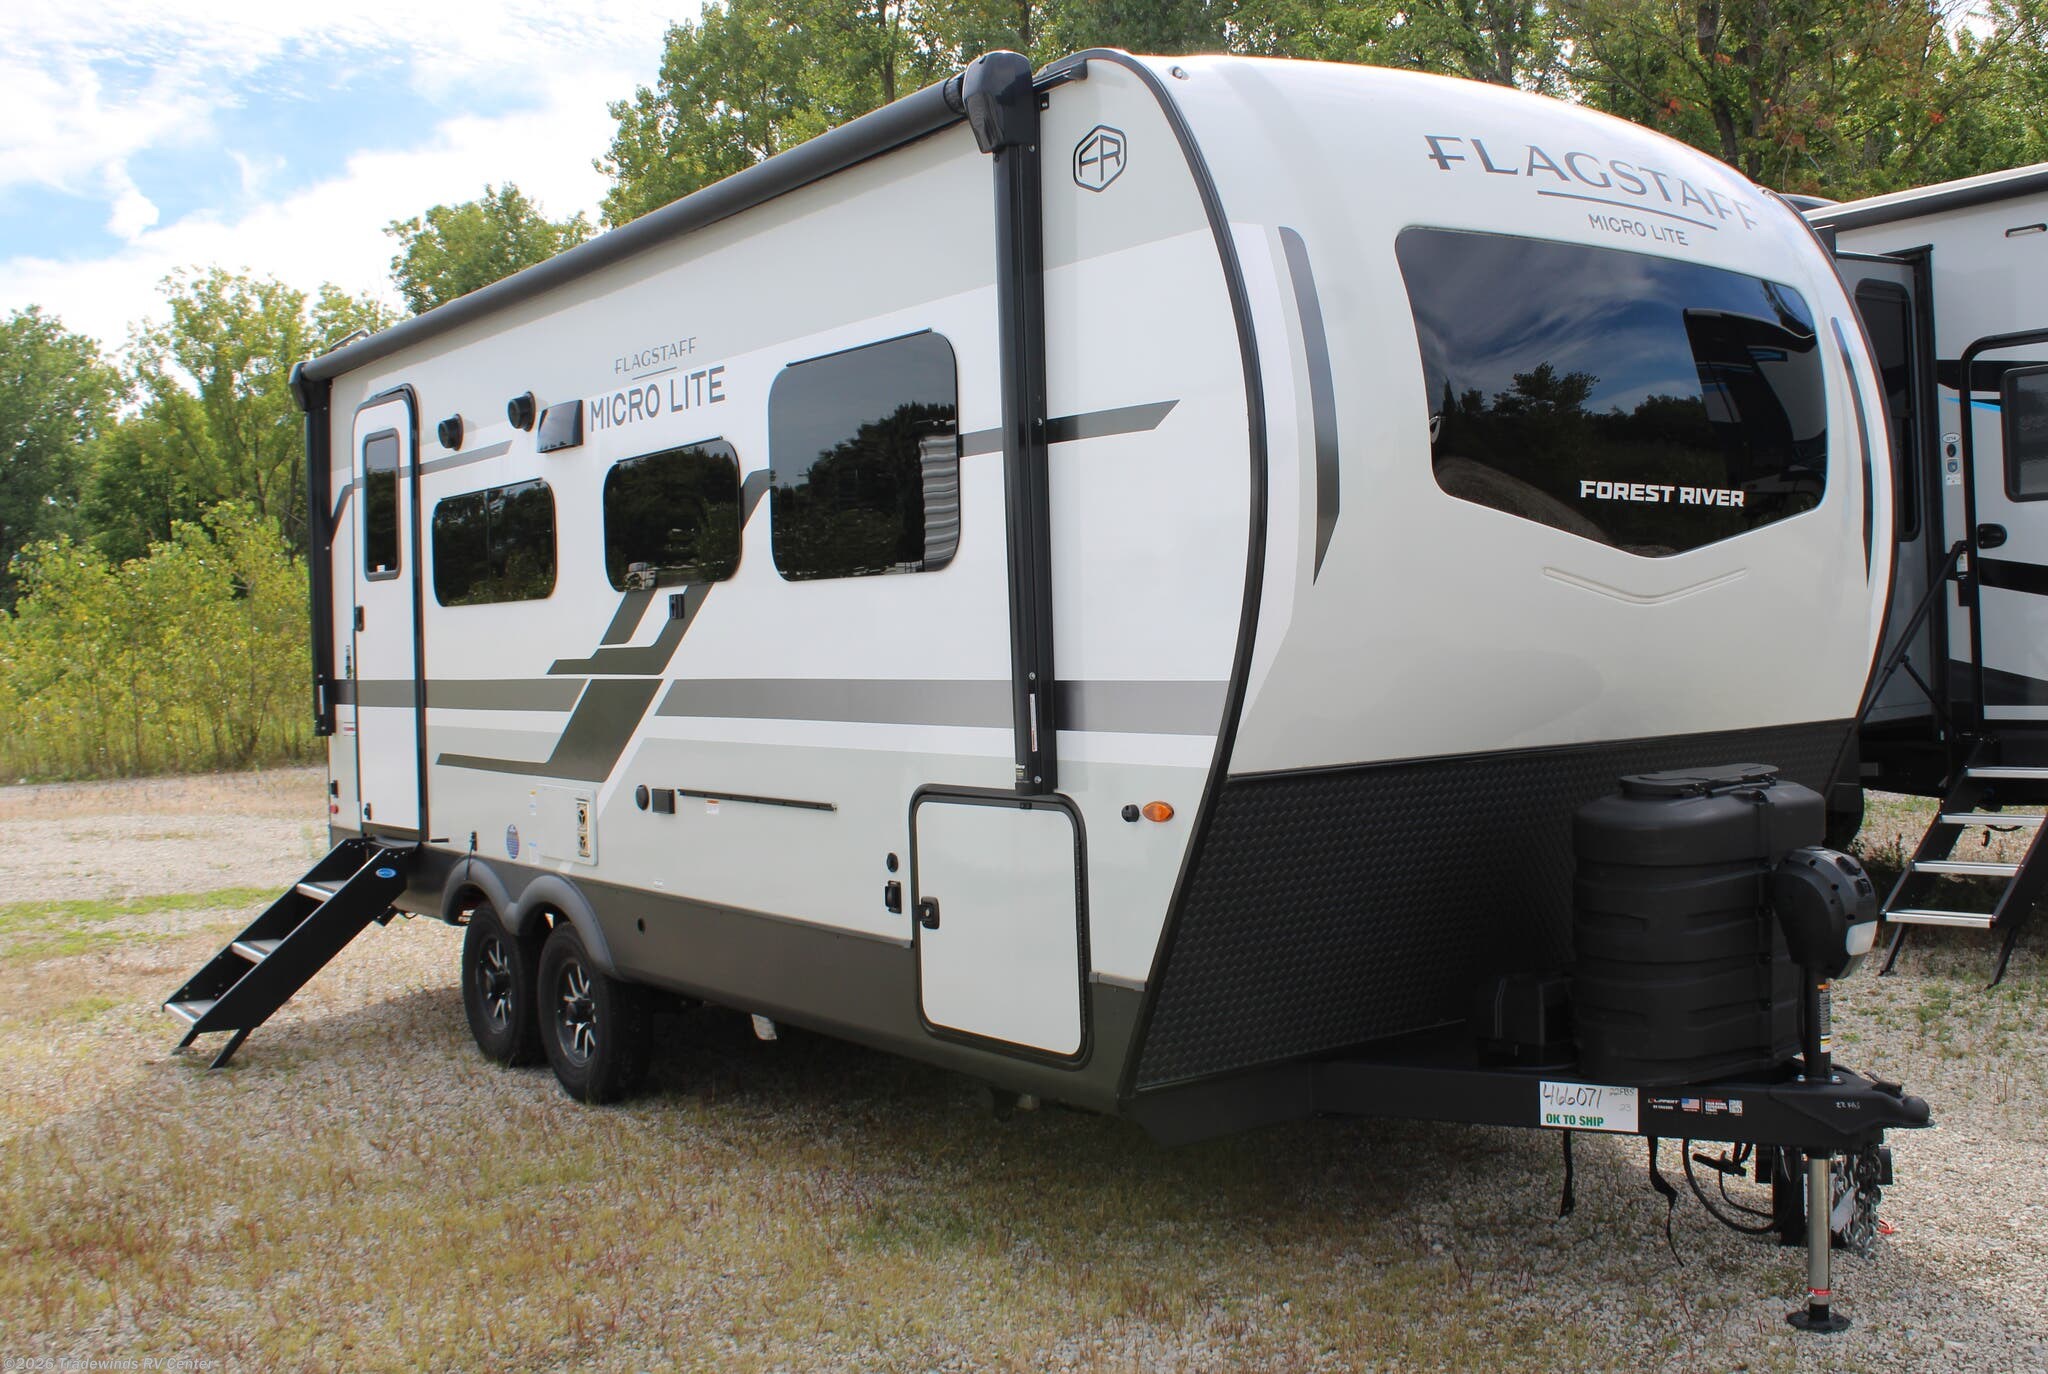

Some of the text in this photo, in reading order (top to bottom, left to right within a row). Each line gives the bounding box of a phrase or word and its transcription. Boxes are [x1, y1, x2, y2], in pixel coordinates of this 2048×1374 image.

[1424, 135, 1759, 231] FLAGSTAFF
[1588, 213, 1689, 246] MICRO LITE
[615, 336, 697, 375] FLAGSTAFF
[590, 365, 726, 433] MICRO LITE
[1580, 480, 1745, 507] FOREST RIVER
[1543, 1083, 1603, 1109] 466071
[1546, 1113, 1604, 1127] OK TO SHIP
